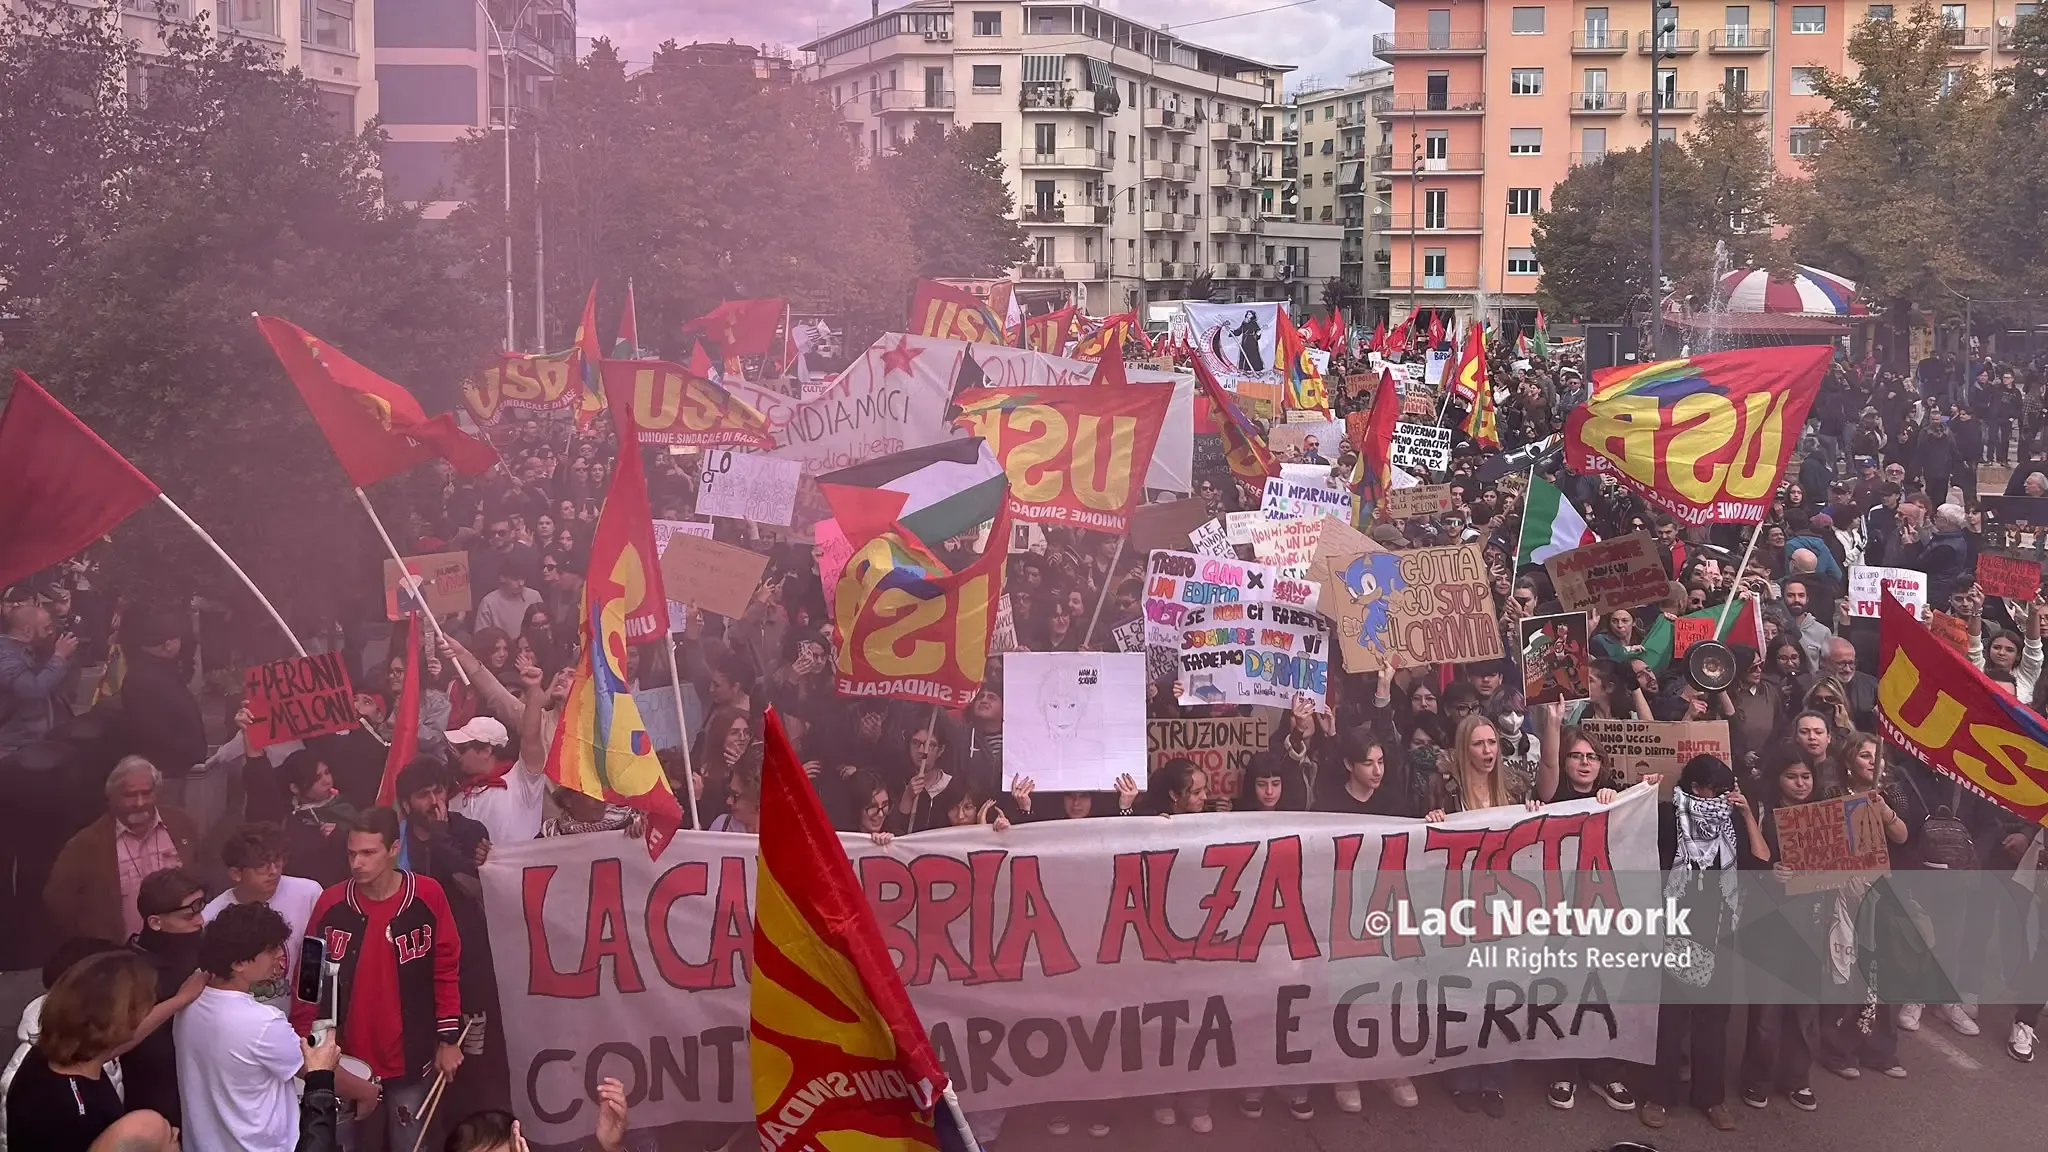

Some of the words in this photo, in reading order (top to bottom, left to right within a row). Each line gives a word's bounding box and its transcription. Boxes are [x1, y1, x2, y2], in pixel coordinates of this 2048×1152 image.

[637, 431, 675, 445] UNIONE
[1400, 424, 1438, 439] GOVERNO
[1439, 430, 1450, 441] HA
[707, 449, 732, 474] LO
[1392, 454, 1406, 465] DEL
[1428, 459, 1443, 470] EX
[1397, 444, 1407, 454] DI
[1408, 446, 1443, 459] ASCOLTO
[1286, 535, 1300, 550] UN
[1202, 560, 1244, 588] GLAM
[1398, 546, 1480, 586] GOTTA
[1147, 576, 1177, 599] UN
[1402, 583, 1435, 617] GO
[1433, 581, 1489, 616] STOP
[1184, 606, 1206, 627] SE
[1212, 603, 1244, 622] NON
[1271, 605, 1328, 632] FARETE
[1857, 600, 1916, 618] FUTO
[1180, 626, 1256, 650] SOGNARE
[1260, 628, 1295, 652] NON
[1404, 612, 1499, 663] CAROVITA
[1244, 649, 1329, 695] DORMIRE
[1604, 723, 1623, 732] MIO
[1626, 723, 1649, 733] DIO!
[1626, 735, 1661, 744] UCCISO
[1600, 744, 1642, 756] OSTRO
[1644, 747, 1676, 756] DIRITTO
[521, 857, 646, 998] LA
[644, 848, 1081, 993] CABRIA
[1095, 834, 1321, 964] ALZA
[1327, 831, 1426, 963] LA
[1423, 810, 1625, 949] TESTA
[526, 1024, 752, 1125] CONT
[929, 994, 1238, 1094] AROVITA
[1275, 984, 1313, 1066] E
[1332, 969, 1618, 1060] GUERRA
